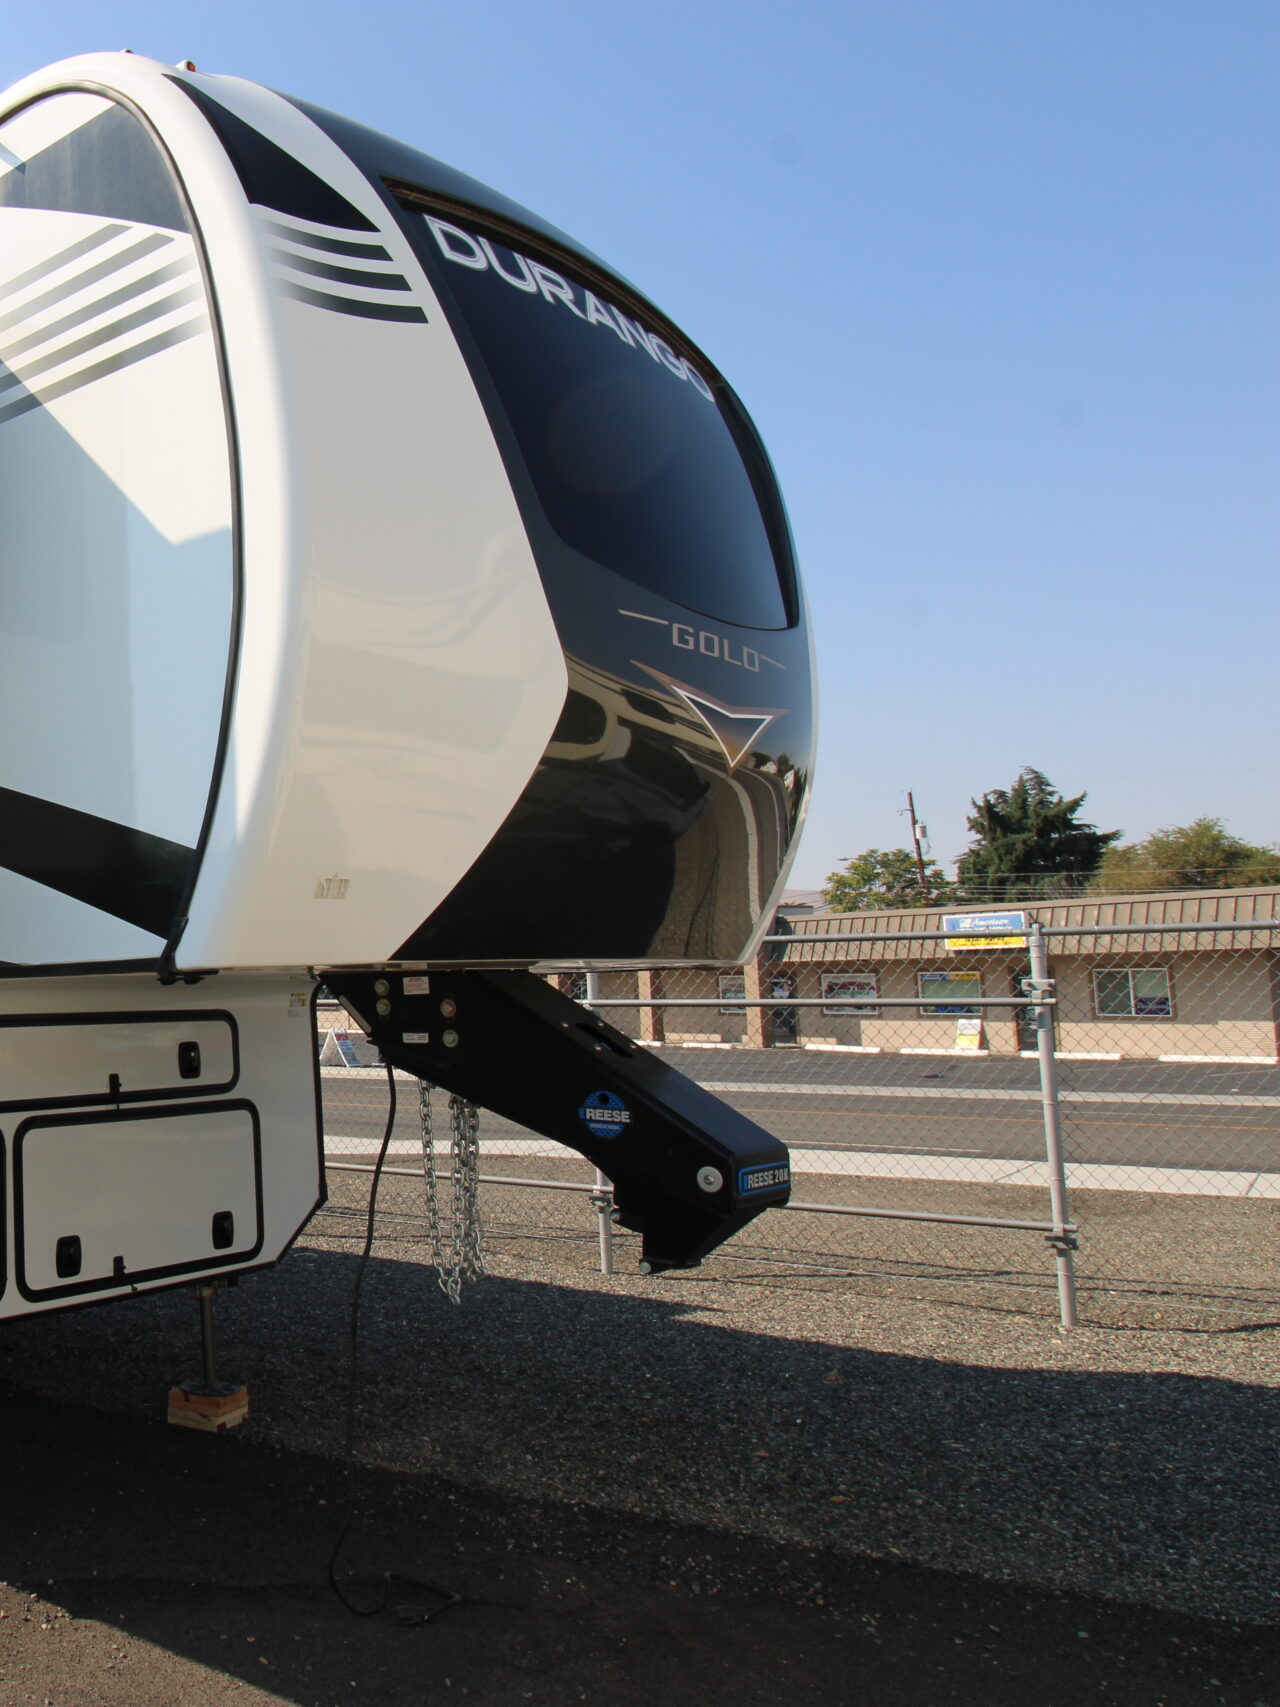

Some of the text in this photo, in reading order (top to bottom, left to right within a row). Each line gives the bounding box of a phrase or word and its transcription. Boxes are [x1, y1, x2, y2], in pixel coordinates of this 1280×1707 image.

[422, 213, 715, 403] DURANGO
[672, 623, 760, 673] GOLD
[586, 1108, 630, 1123] REESE
[748, 1168, 789, 1189] REESE 20K
